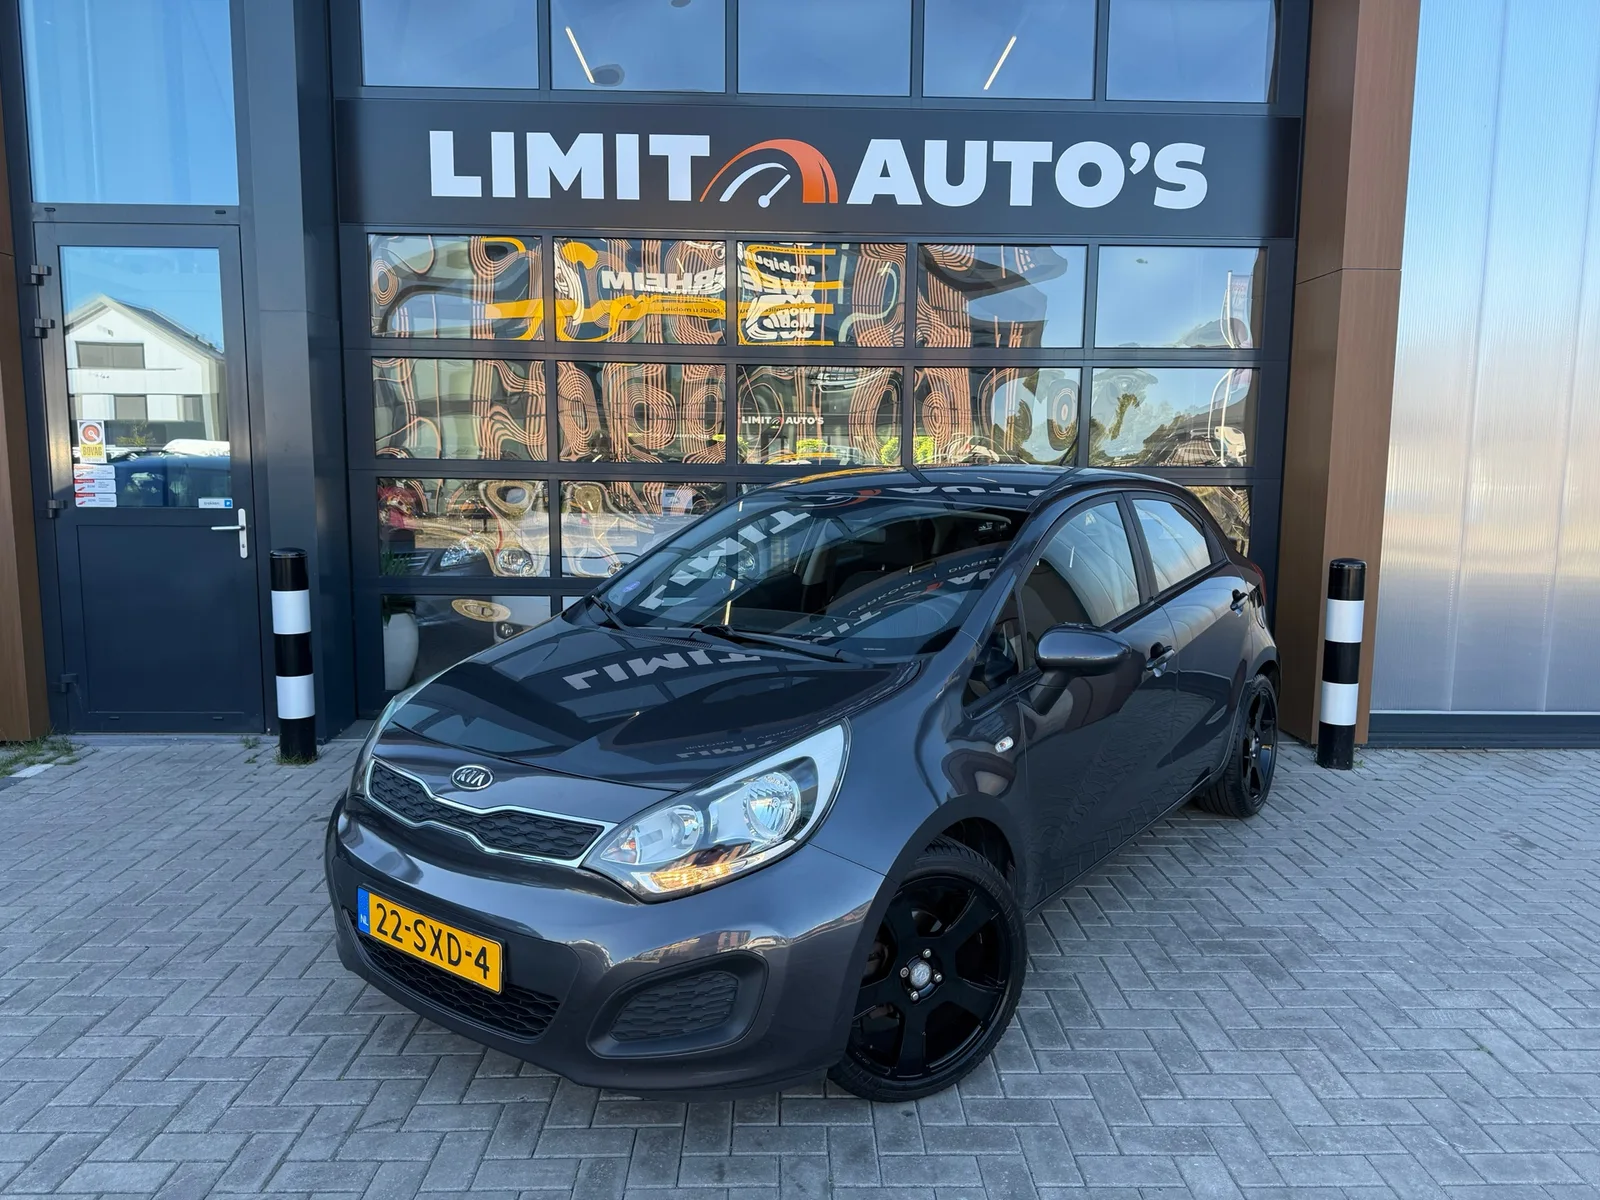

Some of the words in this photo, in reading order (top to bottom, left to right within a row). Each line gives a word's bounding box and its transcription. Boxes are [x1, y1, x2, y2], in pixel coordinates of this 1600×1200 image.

[429, 130, 711, 202] LIMIT
[847, 138, 1208, 210] AUTO'S
[741, 416, 772, 424] LIMIT
[785, 416, 824, 425] AUTO'S
[82, 446, 103, 457] BOVAG
[456, 768, 486, 786] KIA
[359, 913, 369, 926] NL
[375, 902, 491, 981] 22-SXD-4
